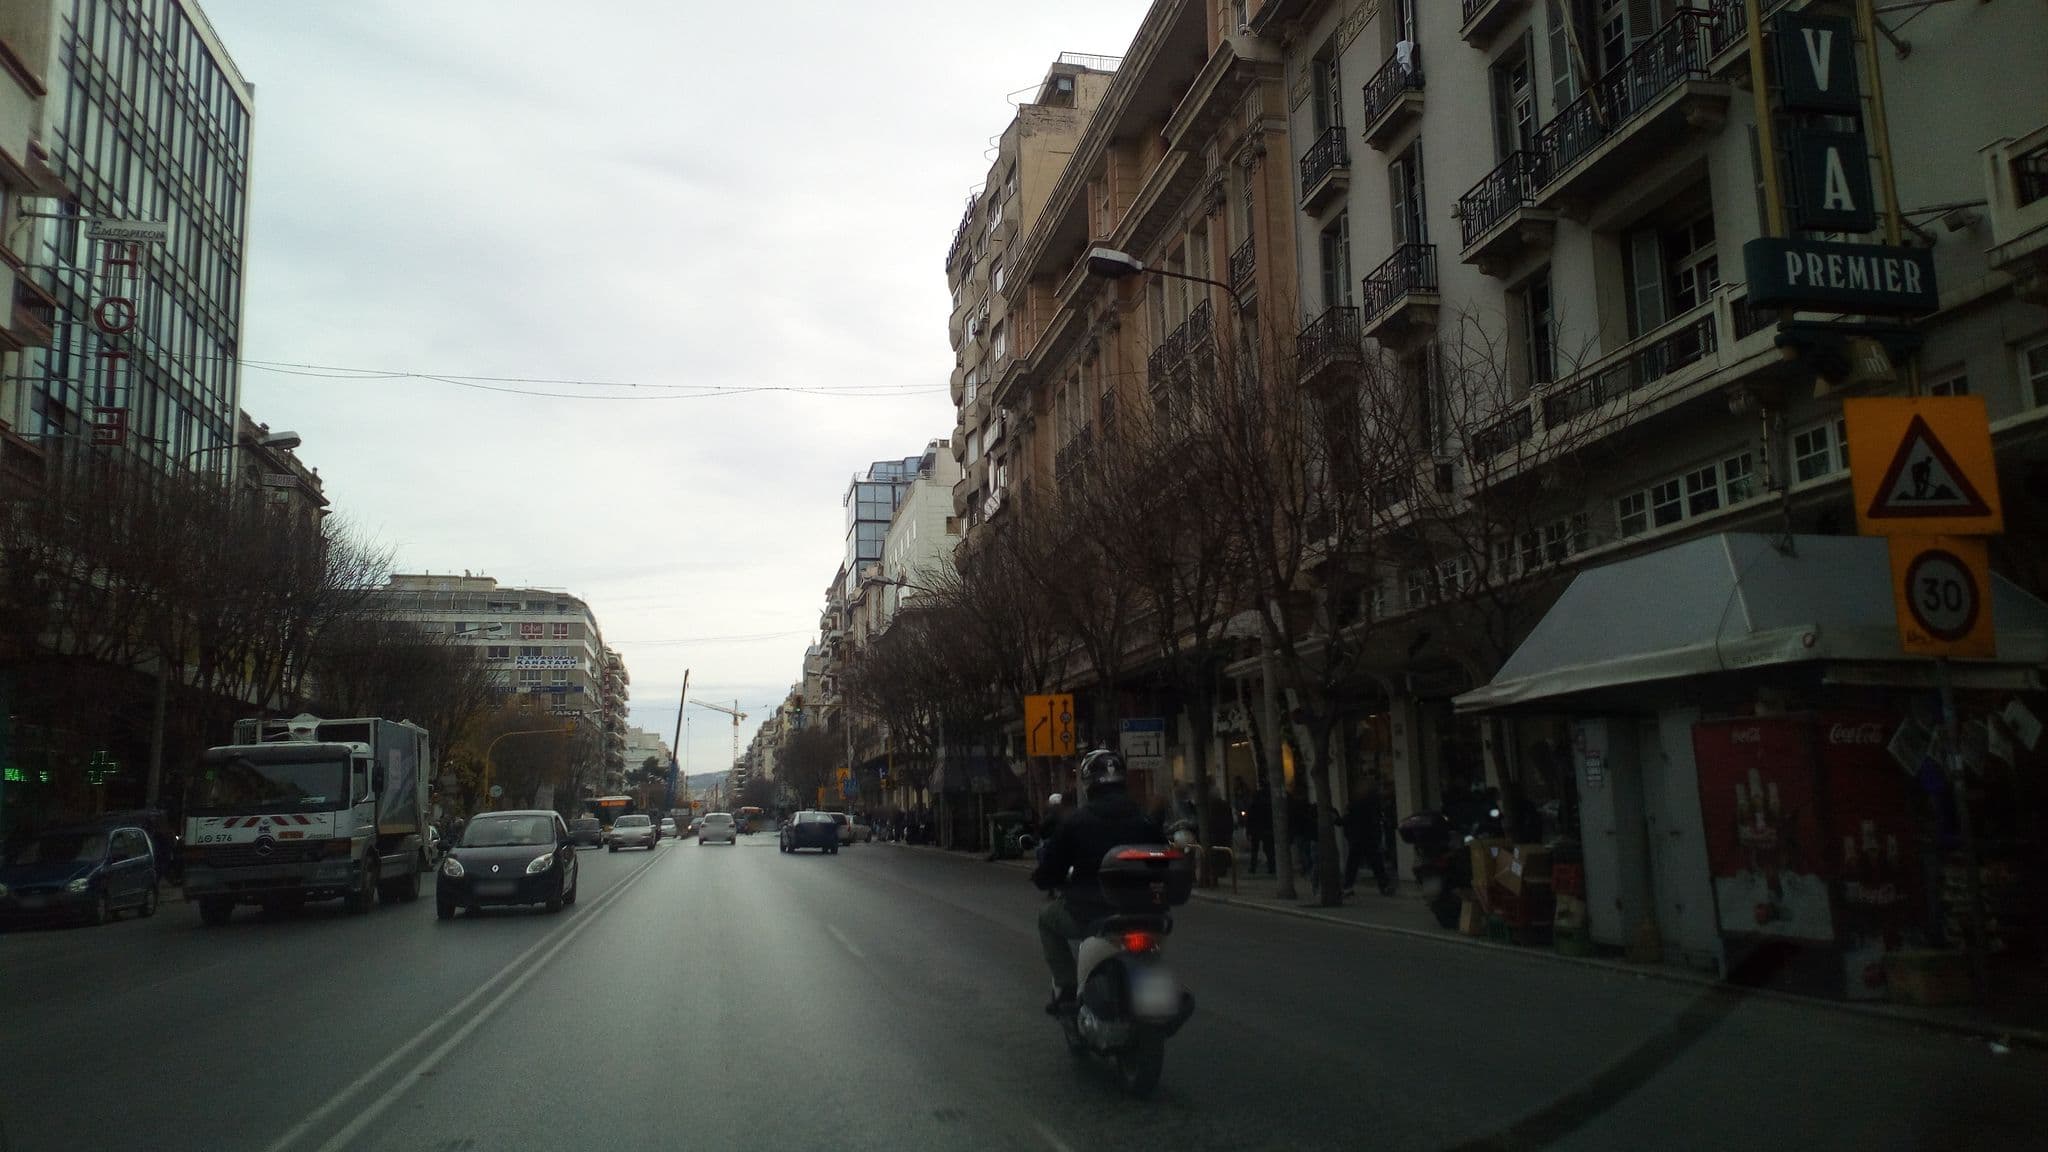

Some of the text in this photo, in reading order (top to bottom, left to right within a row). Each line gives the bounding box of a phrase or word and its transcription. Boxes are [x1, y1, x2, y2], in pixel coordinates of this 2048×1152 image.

[1785, 251, 1922, 294] PREMIER
[1921, 578, 1963, 611] 30
[216, 834, 232, 842] 576
